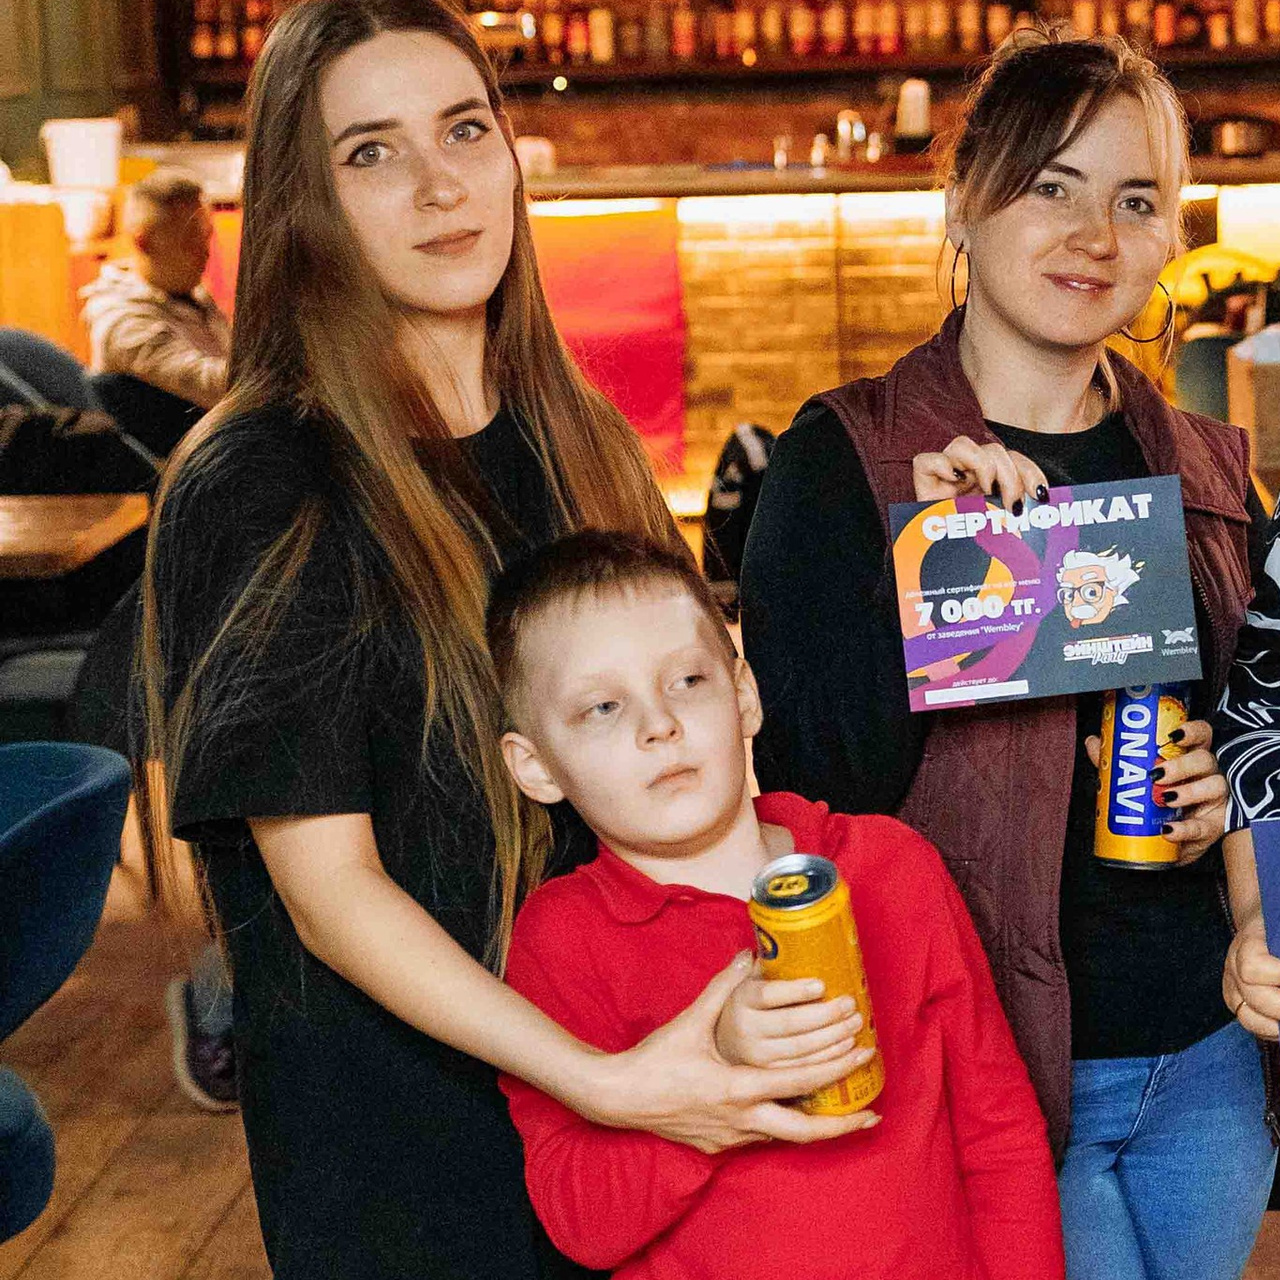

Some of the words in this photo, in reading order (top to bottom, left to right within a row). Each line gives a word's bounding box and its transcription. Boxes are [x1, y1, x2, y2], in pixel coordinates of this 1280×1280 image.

[922, 494, 1152, 541] СЕРТИФИКАТ
[914, 602, 934, 626] 7
[941, 595, 1004, 623] 000
[1161, 646, 1198, 656] Wembley
[1115, 704, 1151, 825] ONAVI
